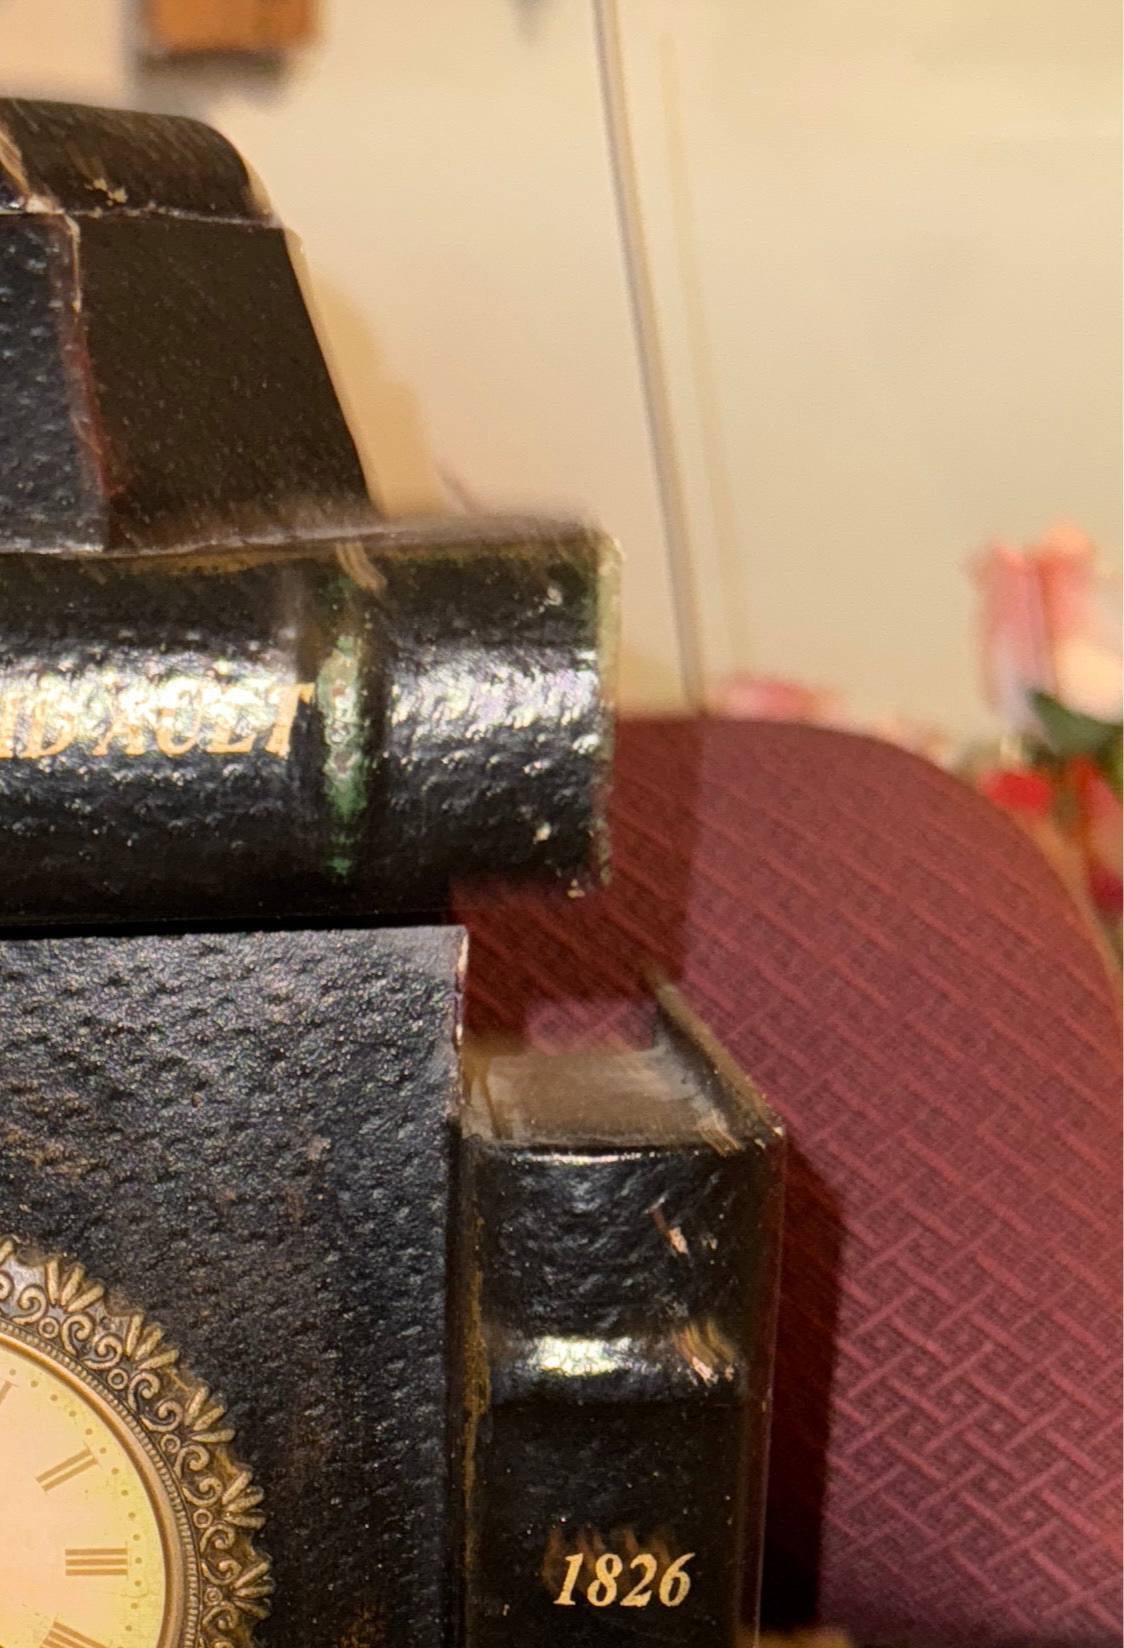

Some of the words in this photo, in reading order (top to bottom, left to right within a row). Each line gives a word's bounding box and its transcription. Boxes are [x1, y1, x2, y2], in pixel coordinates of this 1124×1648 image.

[35, 1444, 100, 1493] II
[65, 1547, 128, 1577] III
[552, 1552, 696, 1607] 1826
